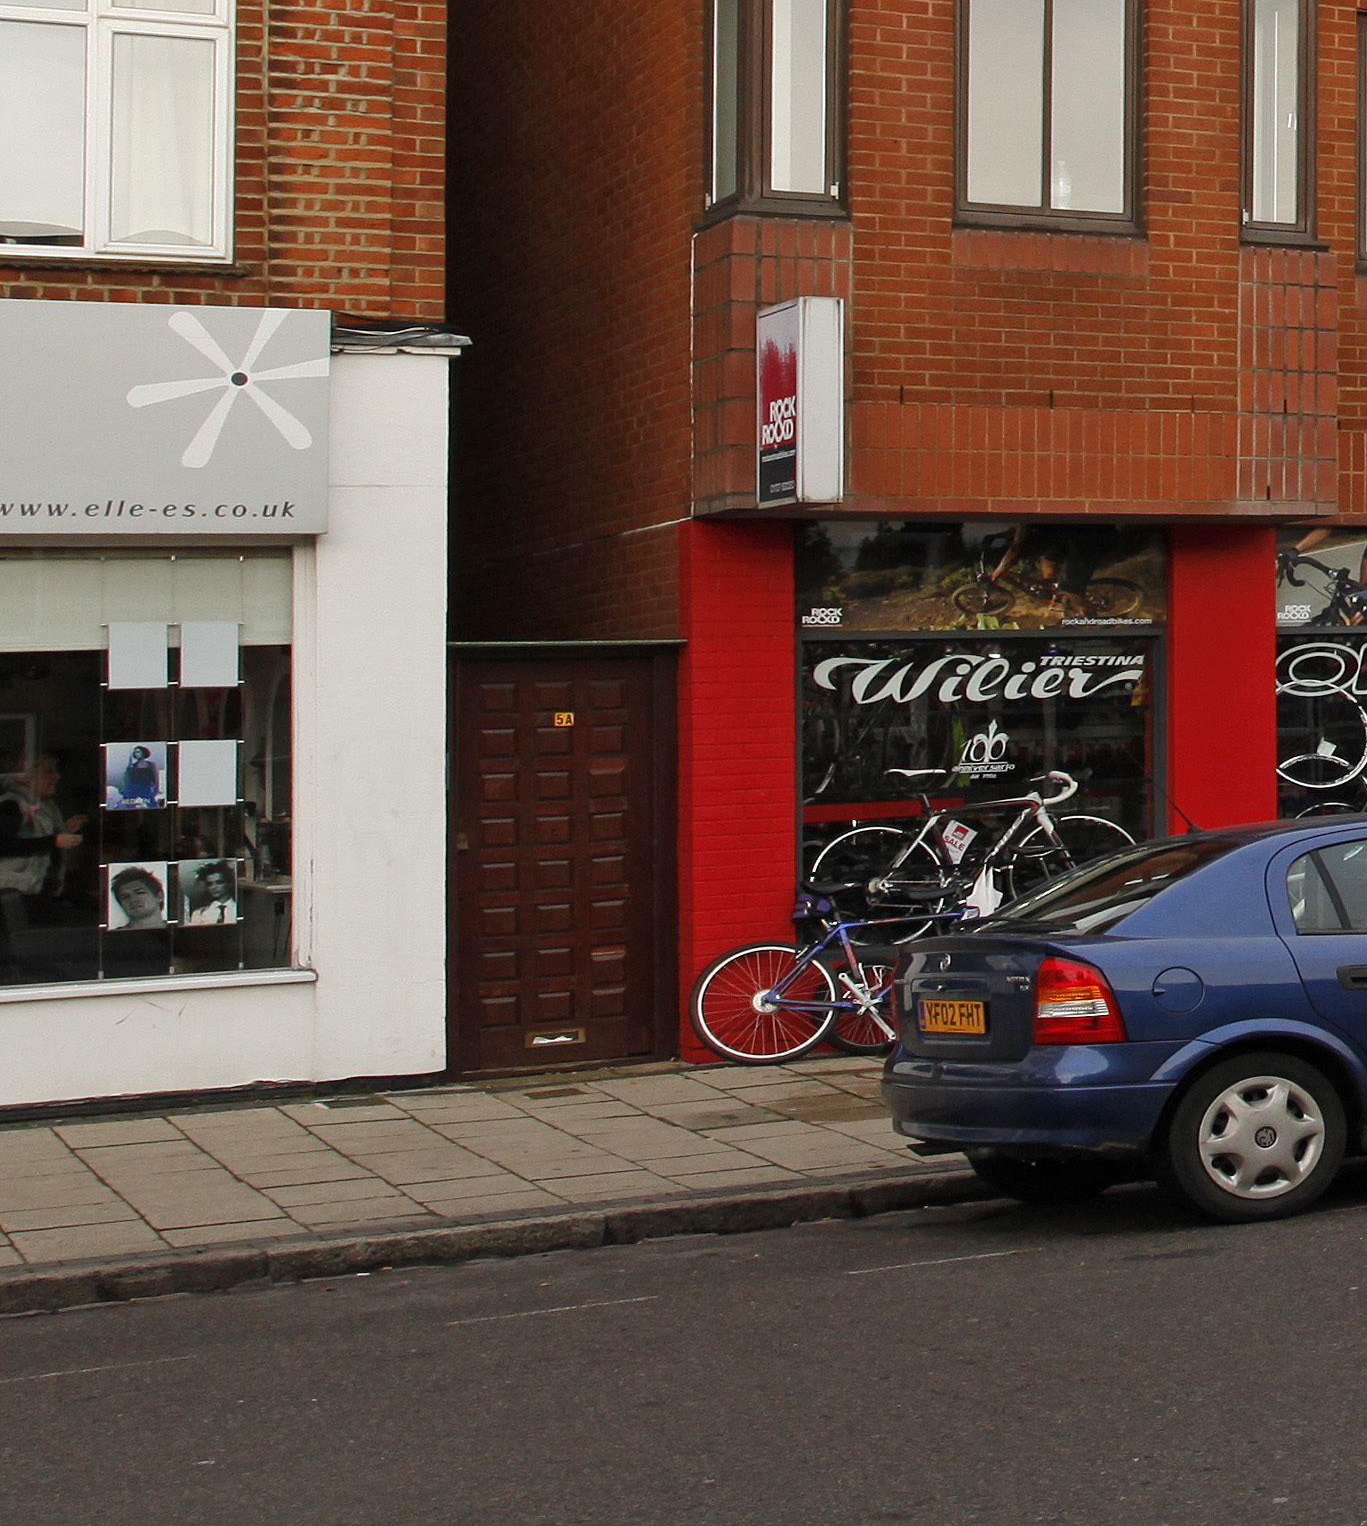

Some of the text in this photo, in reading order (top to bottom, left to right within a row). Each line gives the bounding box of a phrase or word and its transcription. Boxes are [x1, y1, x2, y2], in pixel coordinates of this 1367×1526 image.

[811, 607, 843, 616] ROCK
[1039, 655, 1145, 667] TRIESTINA
[813, 654, 1144, 705] Wilier
[556, 713, 573, 725] 5A
[925, 1002, 982, 1027] YF02 FHT
